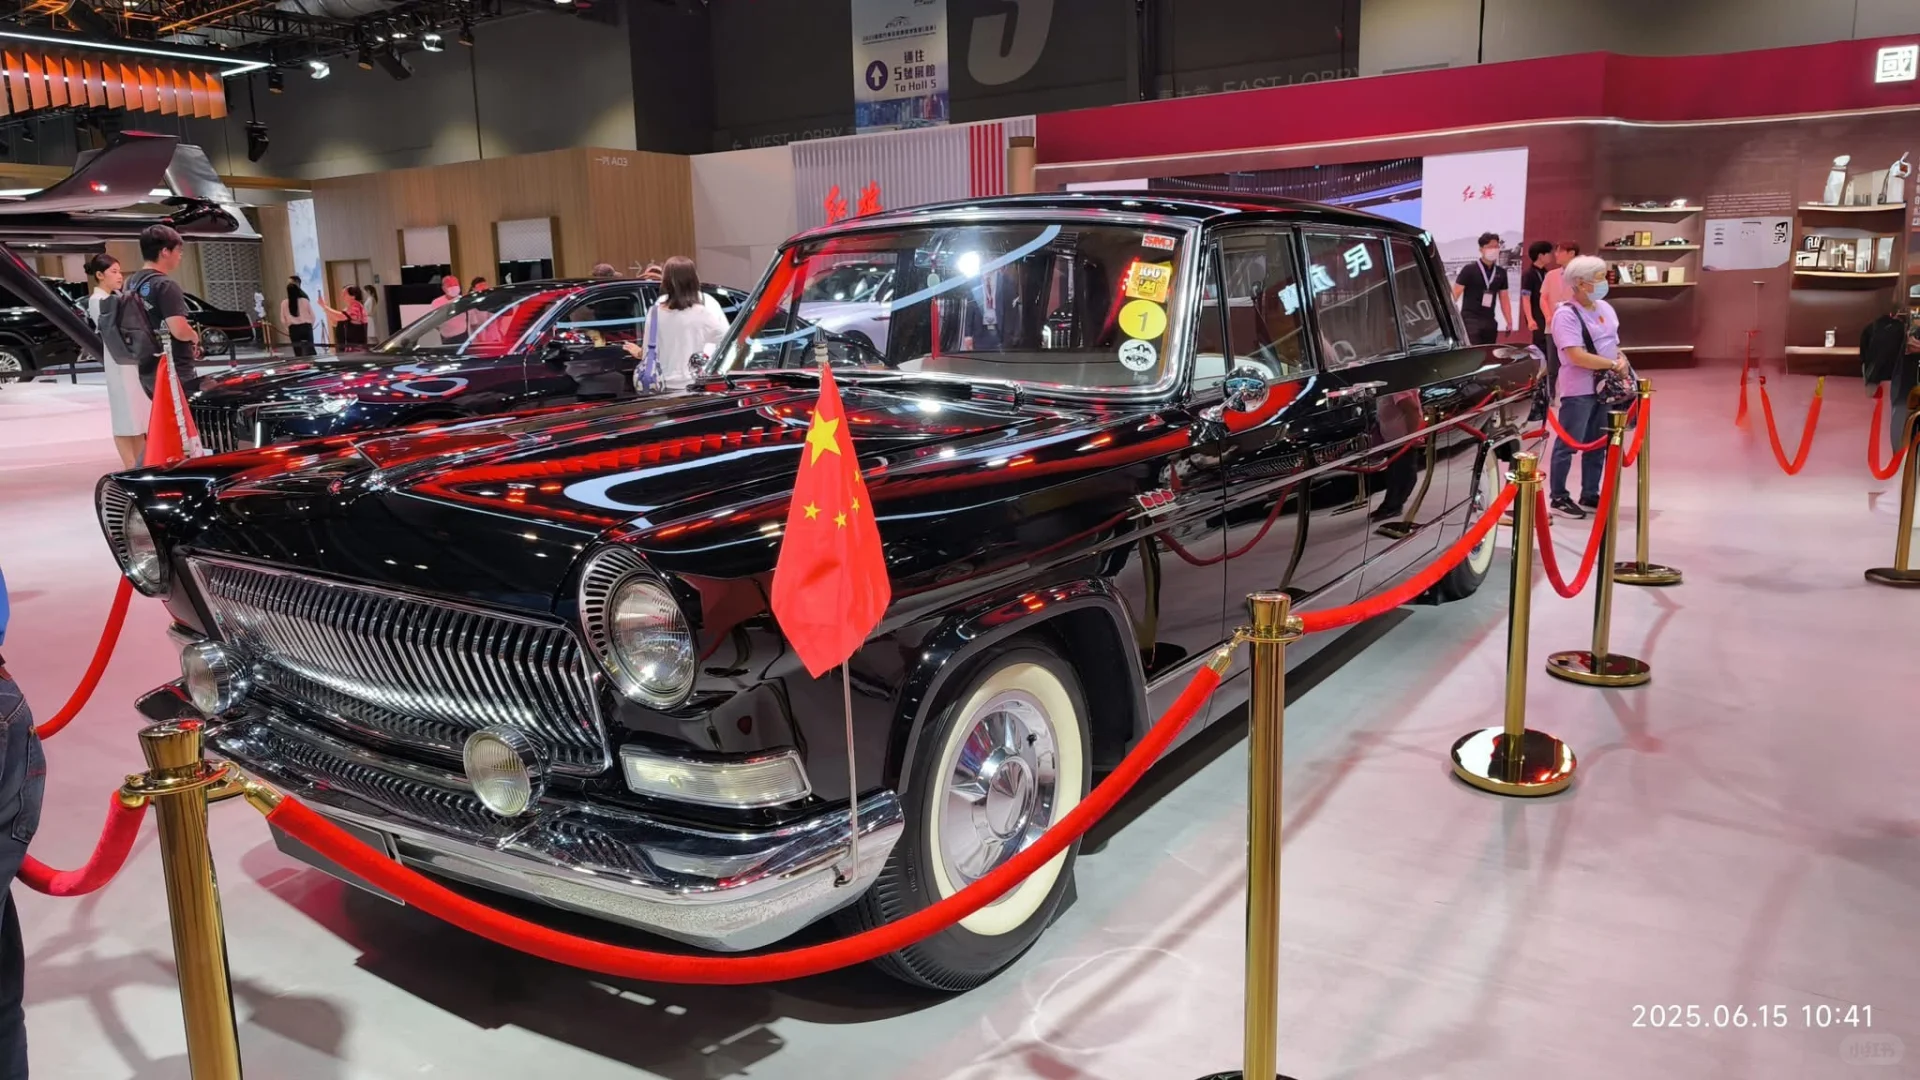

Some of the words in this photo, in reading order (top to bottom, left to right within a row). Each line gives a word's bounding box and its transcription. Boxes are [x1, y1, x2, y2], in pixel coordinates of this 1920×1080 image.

[894, 83, 906, 93] To
[908, 80, 928, 91] Hall
[930, 79, 937, 89] 5
[1137, 311, 1149, 333] 1
